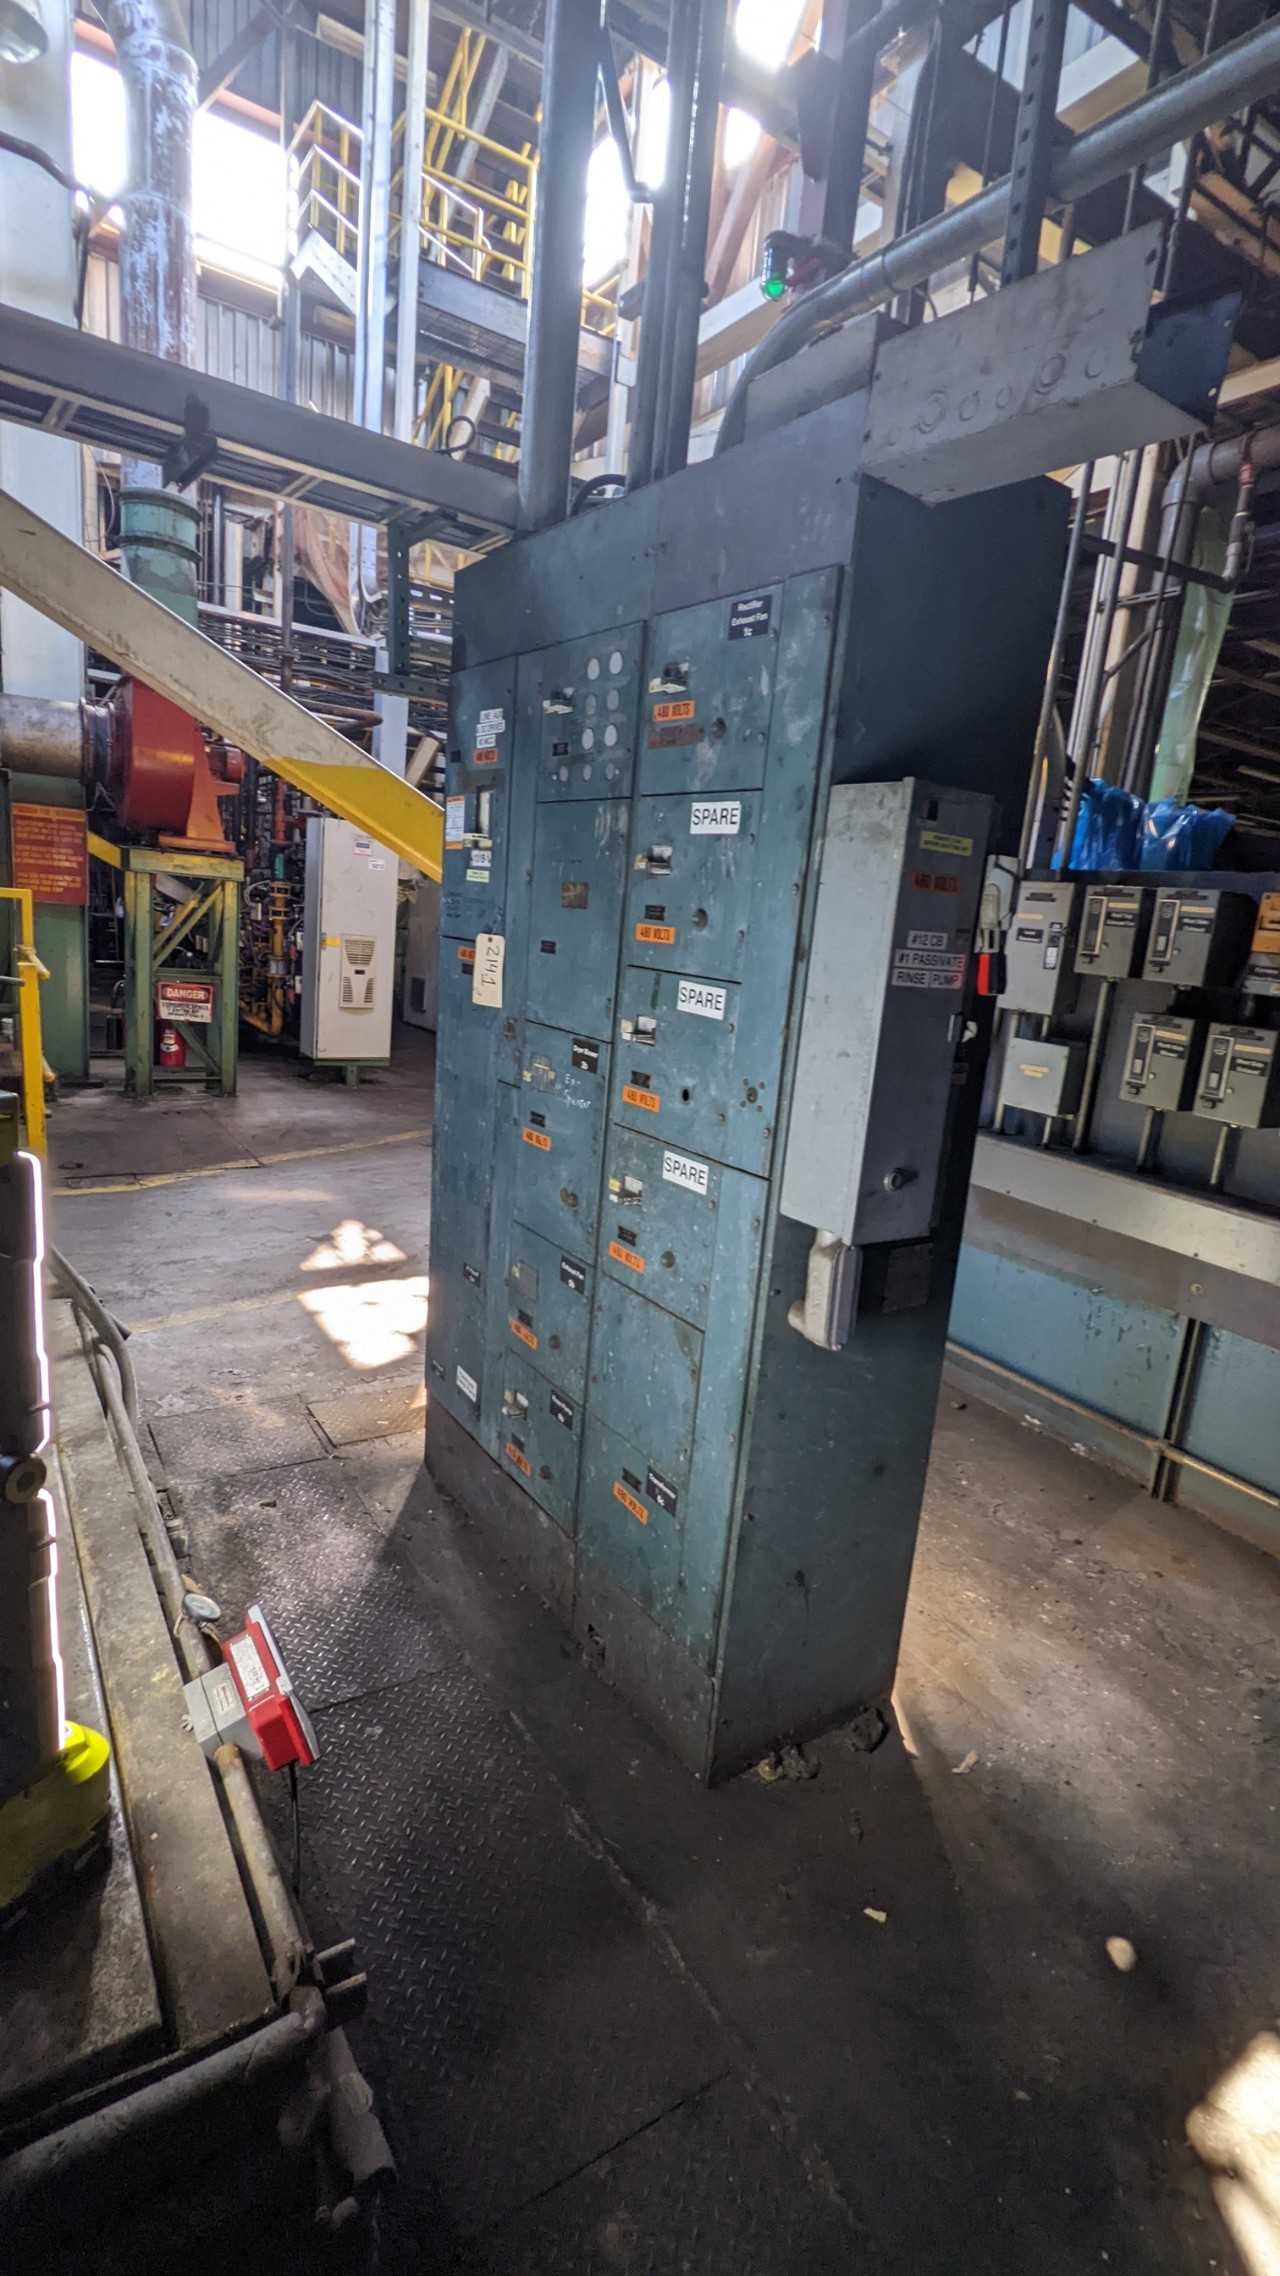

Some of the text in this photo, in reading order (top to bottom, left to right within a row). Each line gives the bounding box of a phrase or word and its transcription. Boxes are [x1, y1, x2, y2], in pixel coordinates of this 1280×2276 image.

[671, 702, 690, 717] VOLTS
[692, 808, 739, 826] SPARE
[639, 926, 671, 941] 480 VOLTS
[911, 934, 928, 946] #12
[912, 954, 965, 969] PASSIVATE
[896, 971, 959, 987] RINSE PUMP
[167, 988, 204, 1000] DANGER
[680, 986, 723, 1011] SPARE
[664, 1156, 706, 1186] SPARE
